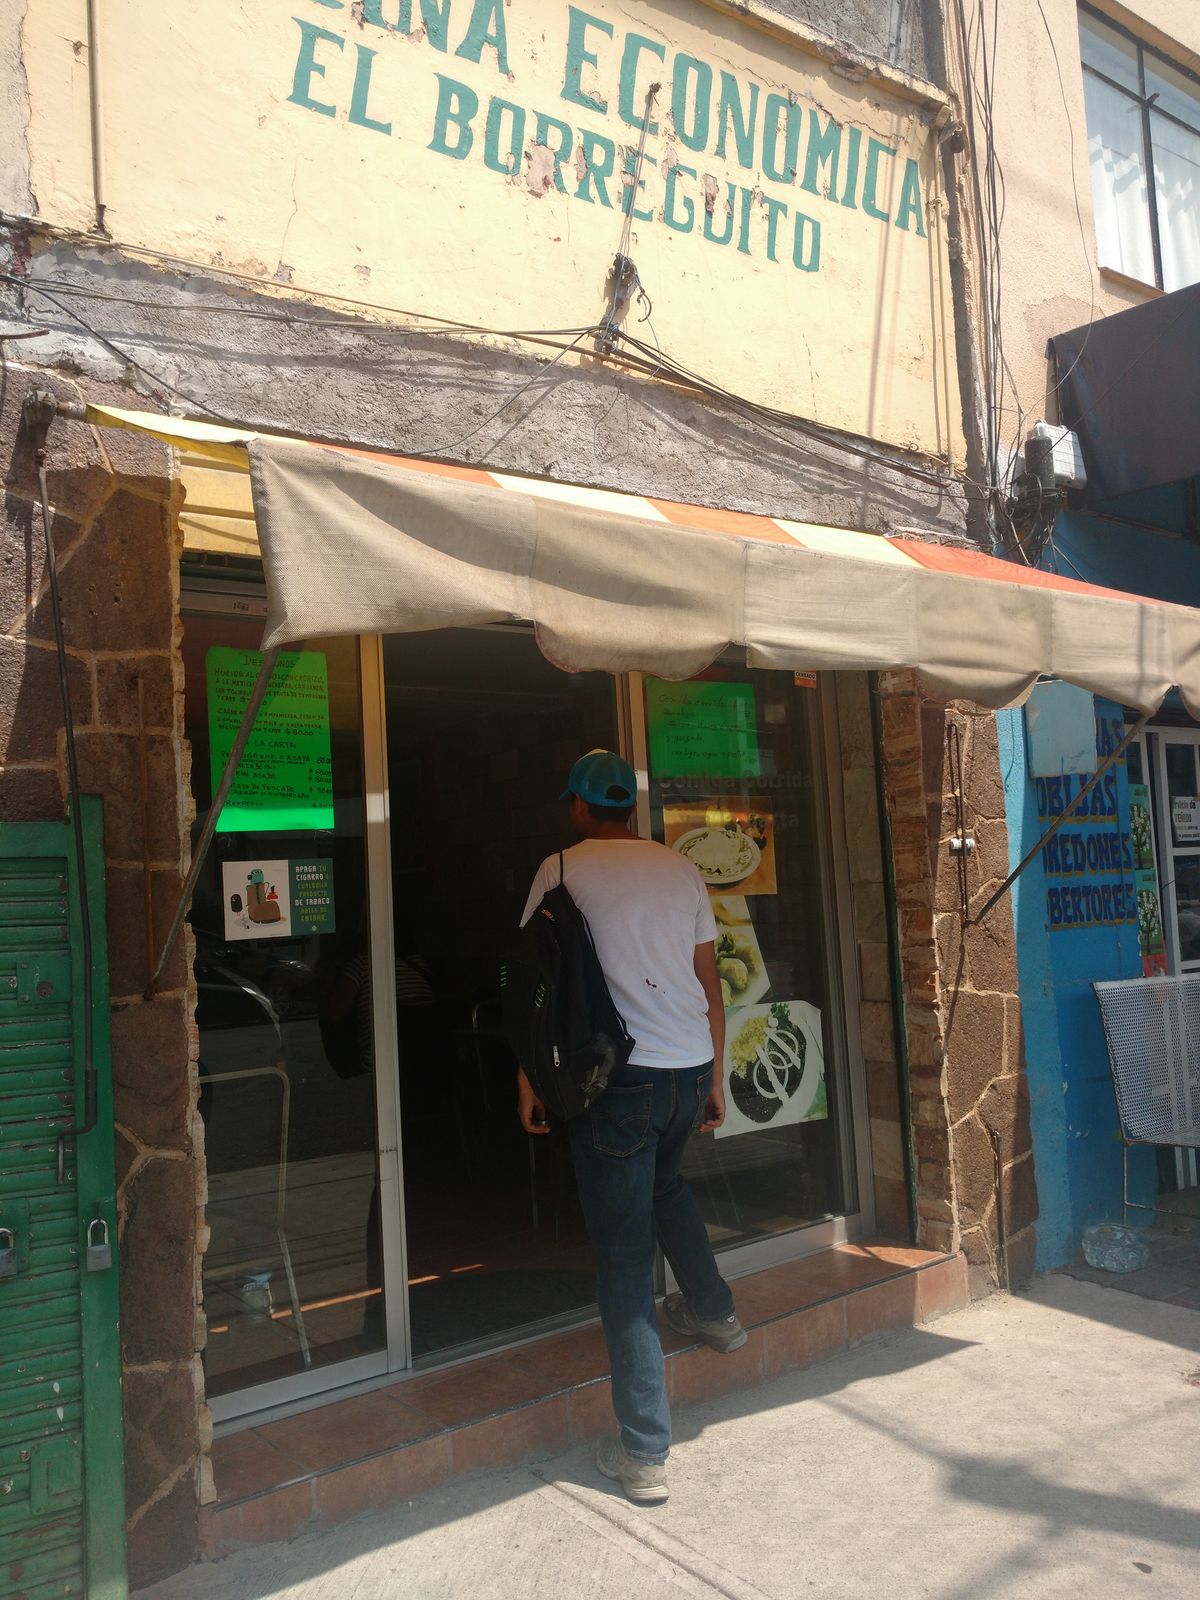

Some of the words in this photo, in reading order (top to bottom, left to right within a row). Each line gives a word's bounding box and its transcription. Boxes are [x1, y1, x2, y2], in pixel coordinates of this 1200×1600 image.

[560, 5, 928, 238] ECONOMICA
[286, 16, 393, 137] EL
[425, 72, 820, 273] BORREGUITO
[296, 874, 324, 882] CIGARRO
[305, 897, 330, 906] TABACO
[1047, 884, 1137, 927] BERTORES
